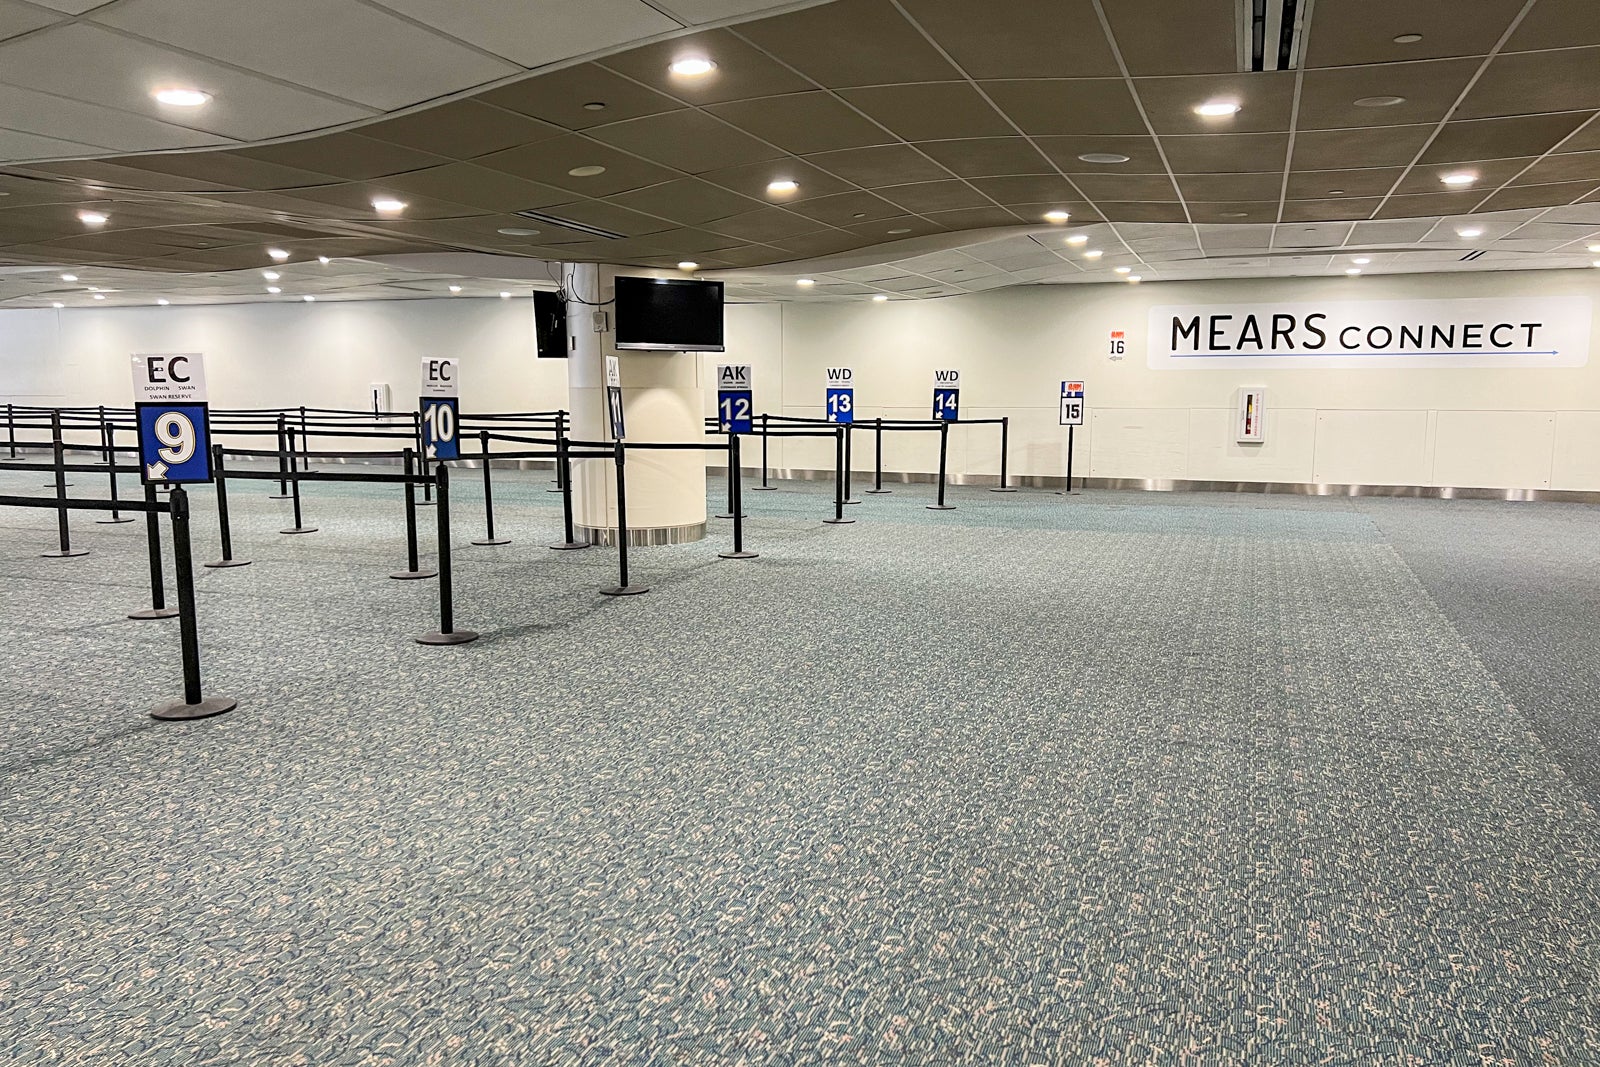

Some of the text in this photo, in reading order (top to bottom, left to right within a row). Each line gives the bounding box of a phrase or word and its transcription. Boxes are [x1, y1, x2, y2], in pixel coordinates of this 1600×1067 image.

[1171, 313, 1543, 351] MEARS CONNECT
[1110, 340, 1125, 354] 16
[147, 356, 191, 383] EC
[429, 360, 451, 381] EC
[722, 366, 746, 380] AK
[827, 368, 852, 380] WD
[935, 370, 959, 381] WD
[720, 398, 750, 420] 12
[828, 394, 851, 413] 13
[935, 393, 957, 410] 14
[1065, 403, 1080, 419] 15
[424, 403, 454, 442] 10
[154, 411, 196, 465] 9
